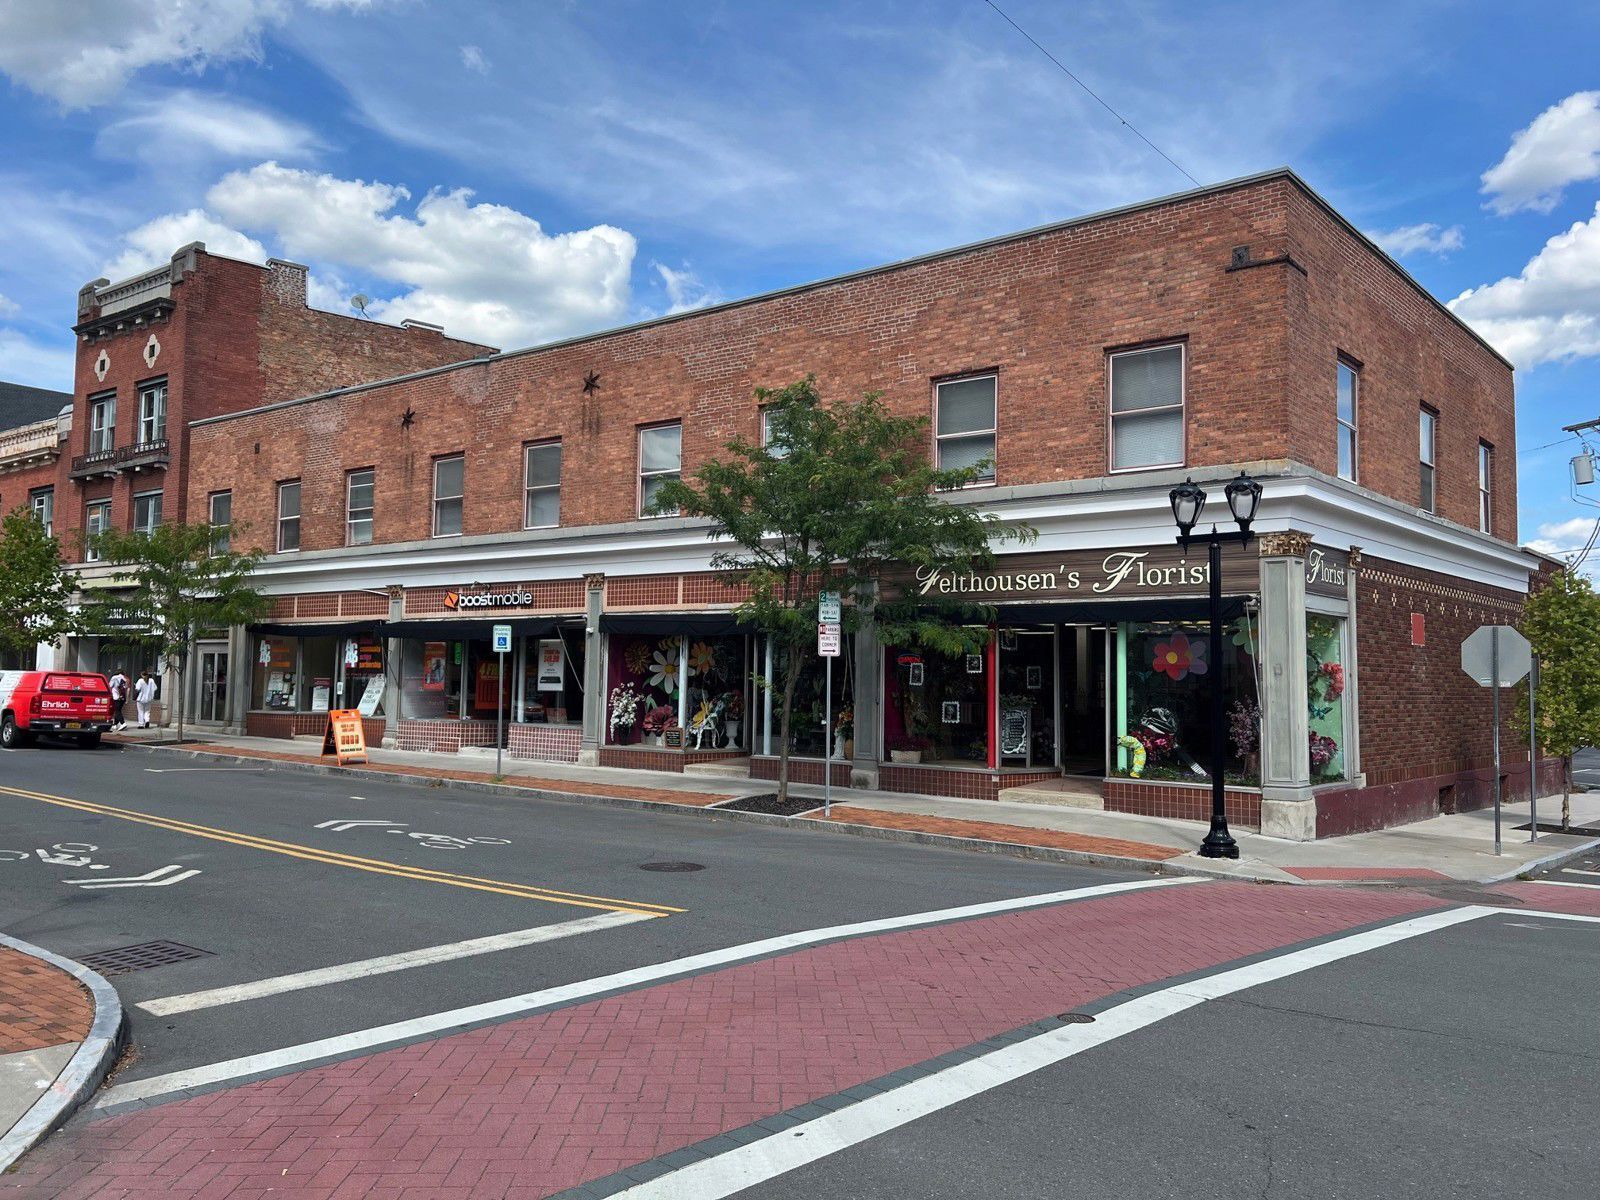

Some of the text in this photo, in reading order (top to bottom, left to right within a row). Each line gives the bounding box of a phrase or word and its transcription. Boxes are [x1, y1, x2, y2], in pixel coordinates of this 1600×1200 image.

[915, 563, 1080, 595] Felthousen's
[1307, 549, 1345, 583] Florist
[41, 700, 69, 708] Ehrlich
